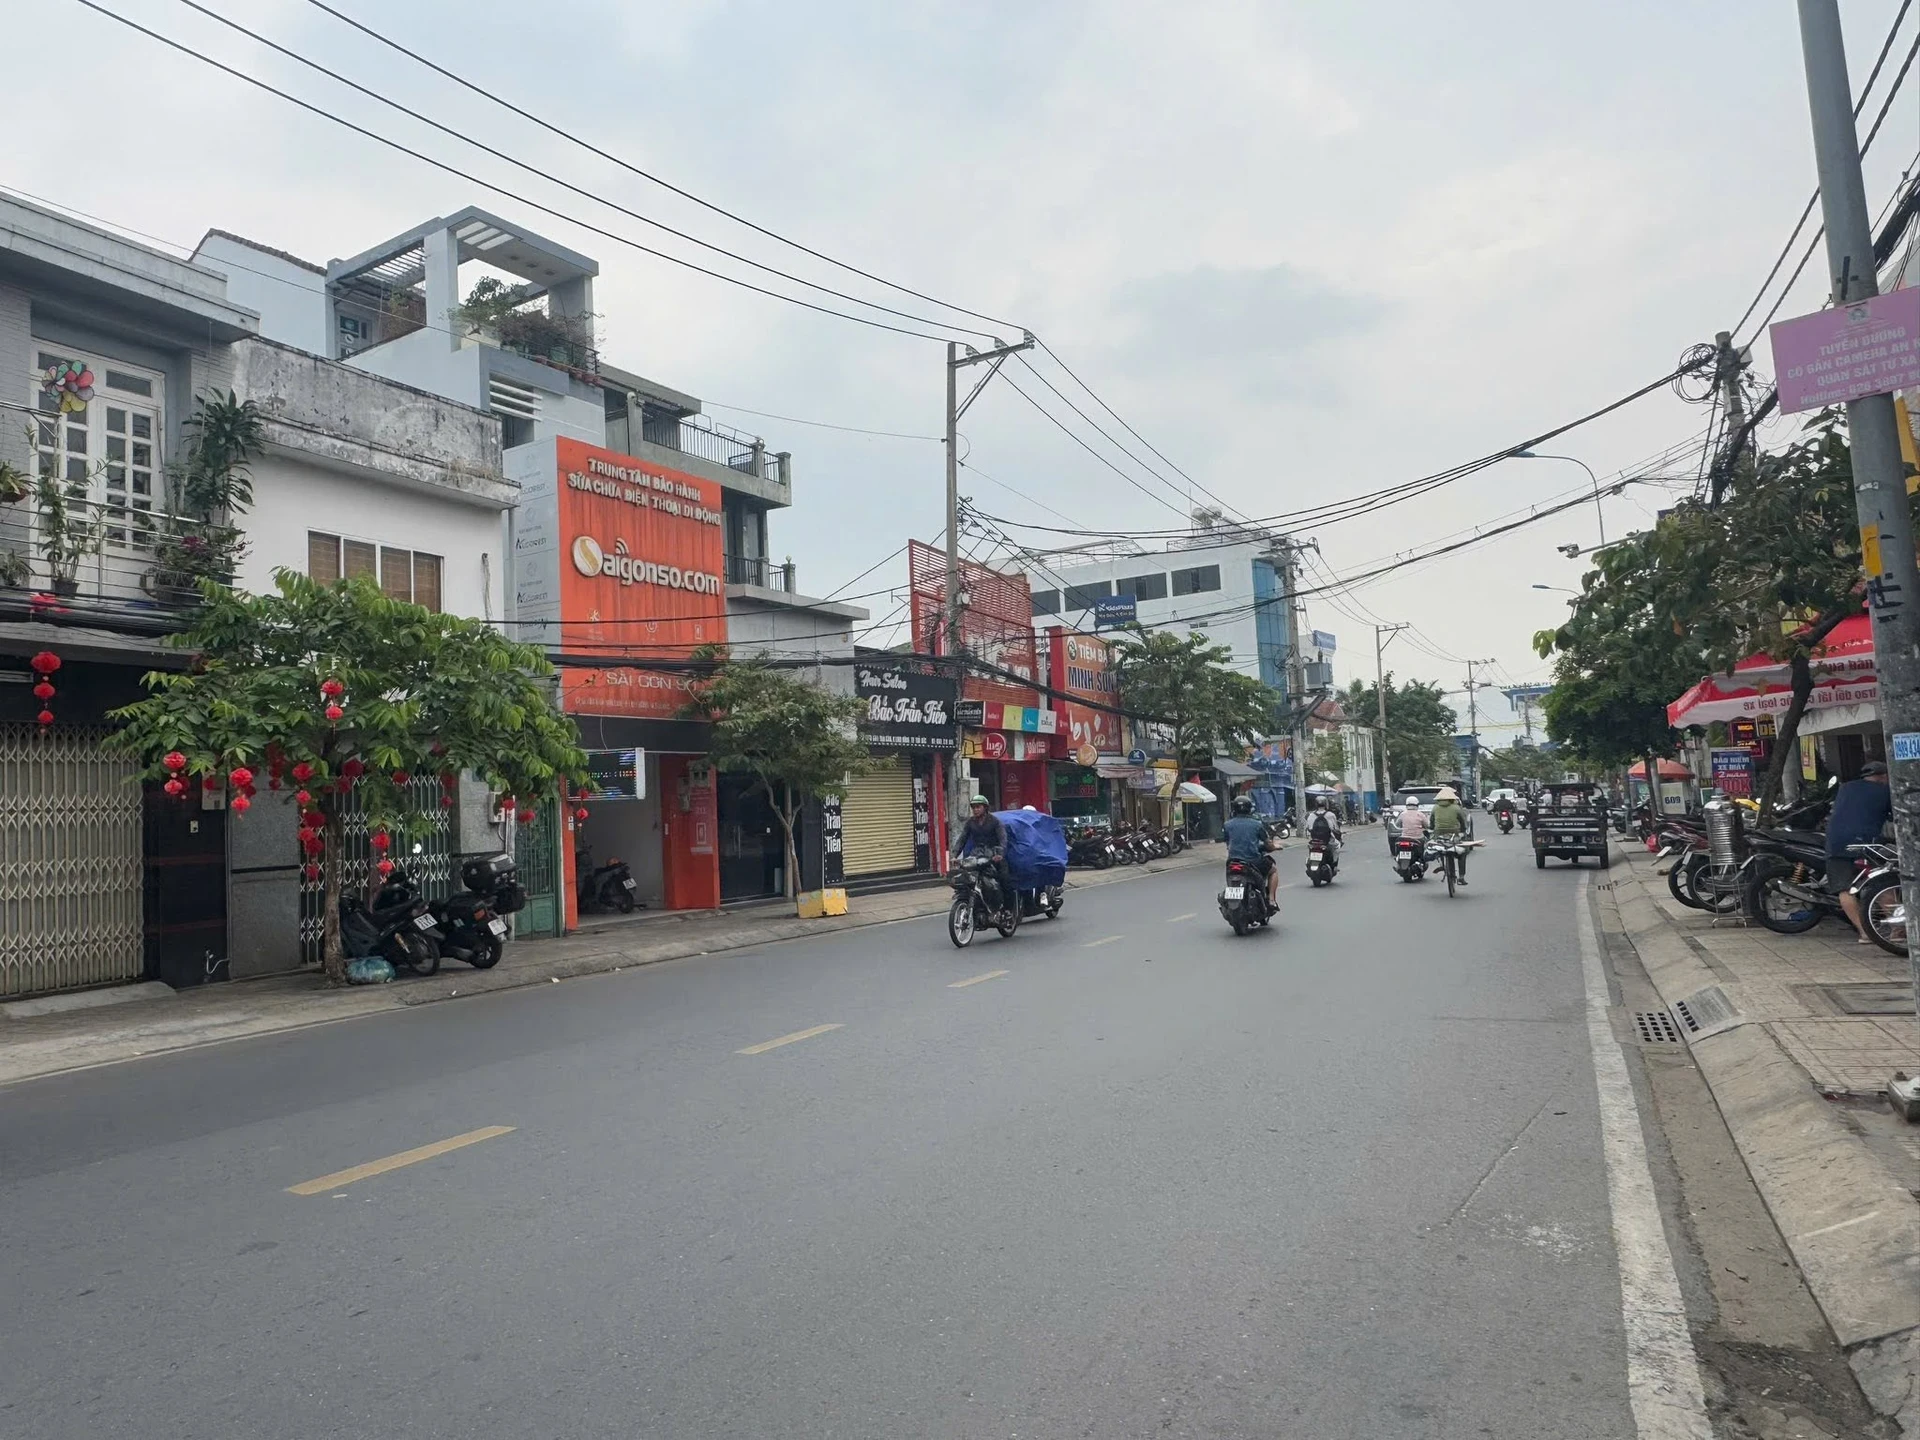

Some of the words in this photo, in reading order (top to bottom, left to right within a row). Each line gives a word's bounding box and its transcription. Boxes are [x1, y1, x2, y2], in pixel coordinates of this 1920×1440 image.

[1836, 347, 1888, 368] CAMERA
[1817, 371, 1850, 387] QUAN
[1900, 354, 1917, 367] XA
[588, 458, 627, 481] TRUNG
[627, 469, 650, 487] TÂM
[652, 475, 674, 493] BẢO
[675, 483, 700, 501] HÀNH
[568, 472, 593, 491] SỬA
[593, 479, 622, 499] CHỮA
[624, 488, 649, 507] ĐIỆN
[651, 496, 681, 516] THOẠI
[683, 505, 694, 518] DI
[695, 506, 721, 526] ĐỘNG
[1078, 641, 1097, 663] TIỆM
[606, 670, 632, 687] SÀI
[859, 669, 881, 687] Hair
[882, 672, 907, 691] Salon
[1069, 666, 1094, 691] MINH
[825, 809, 841, 829] Trần
[825, 832, 841, 853] Tiến
